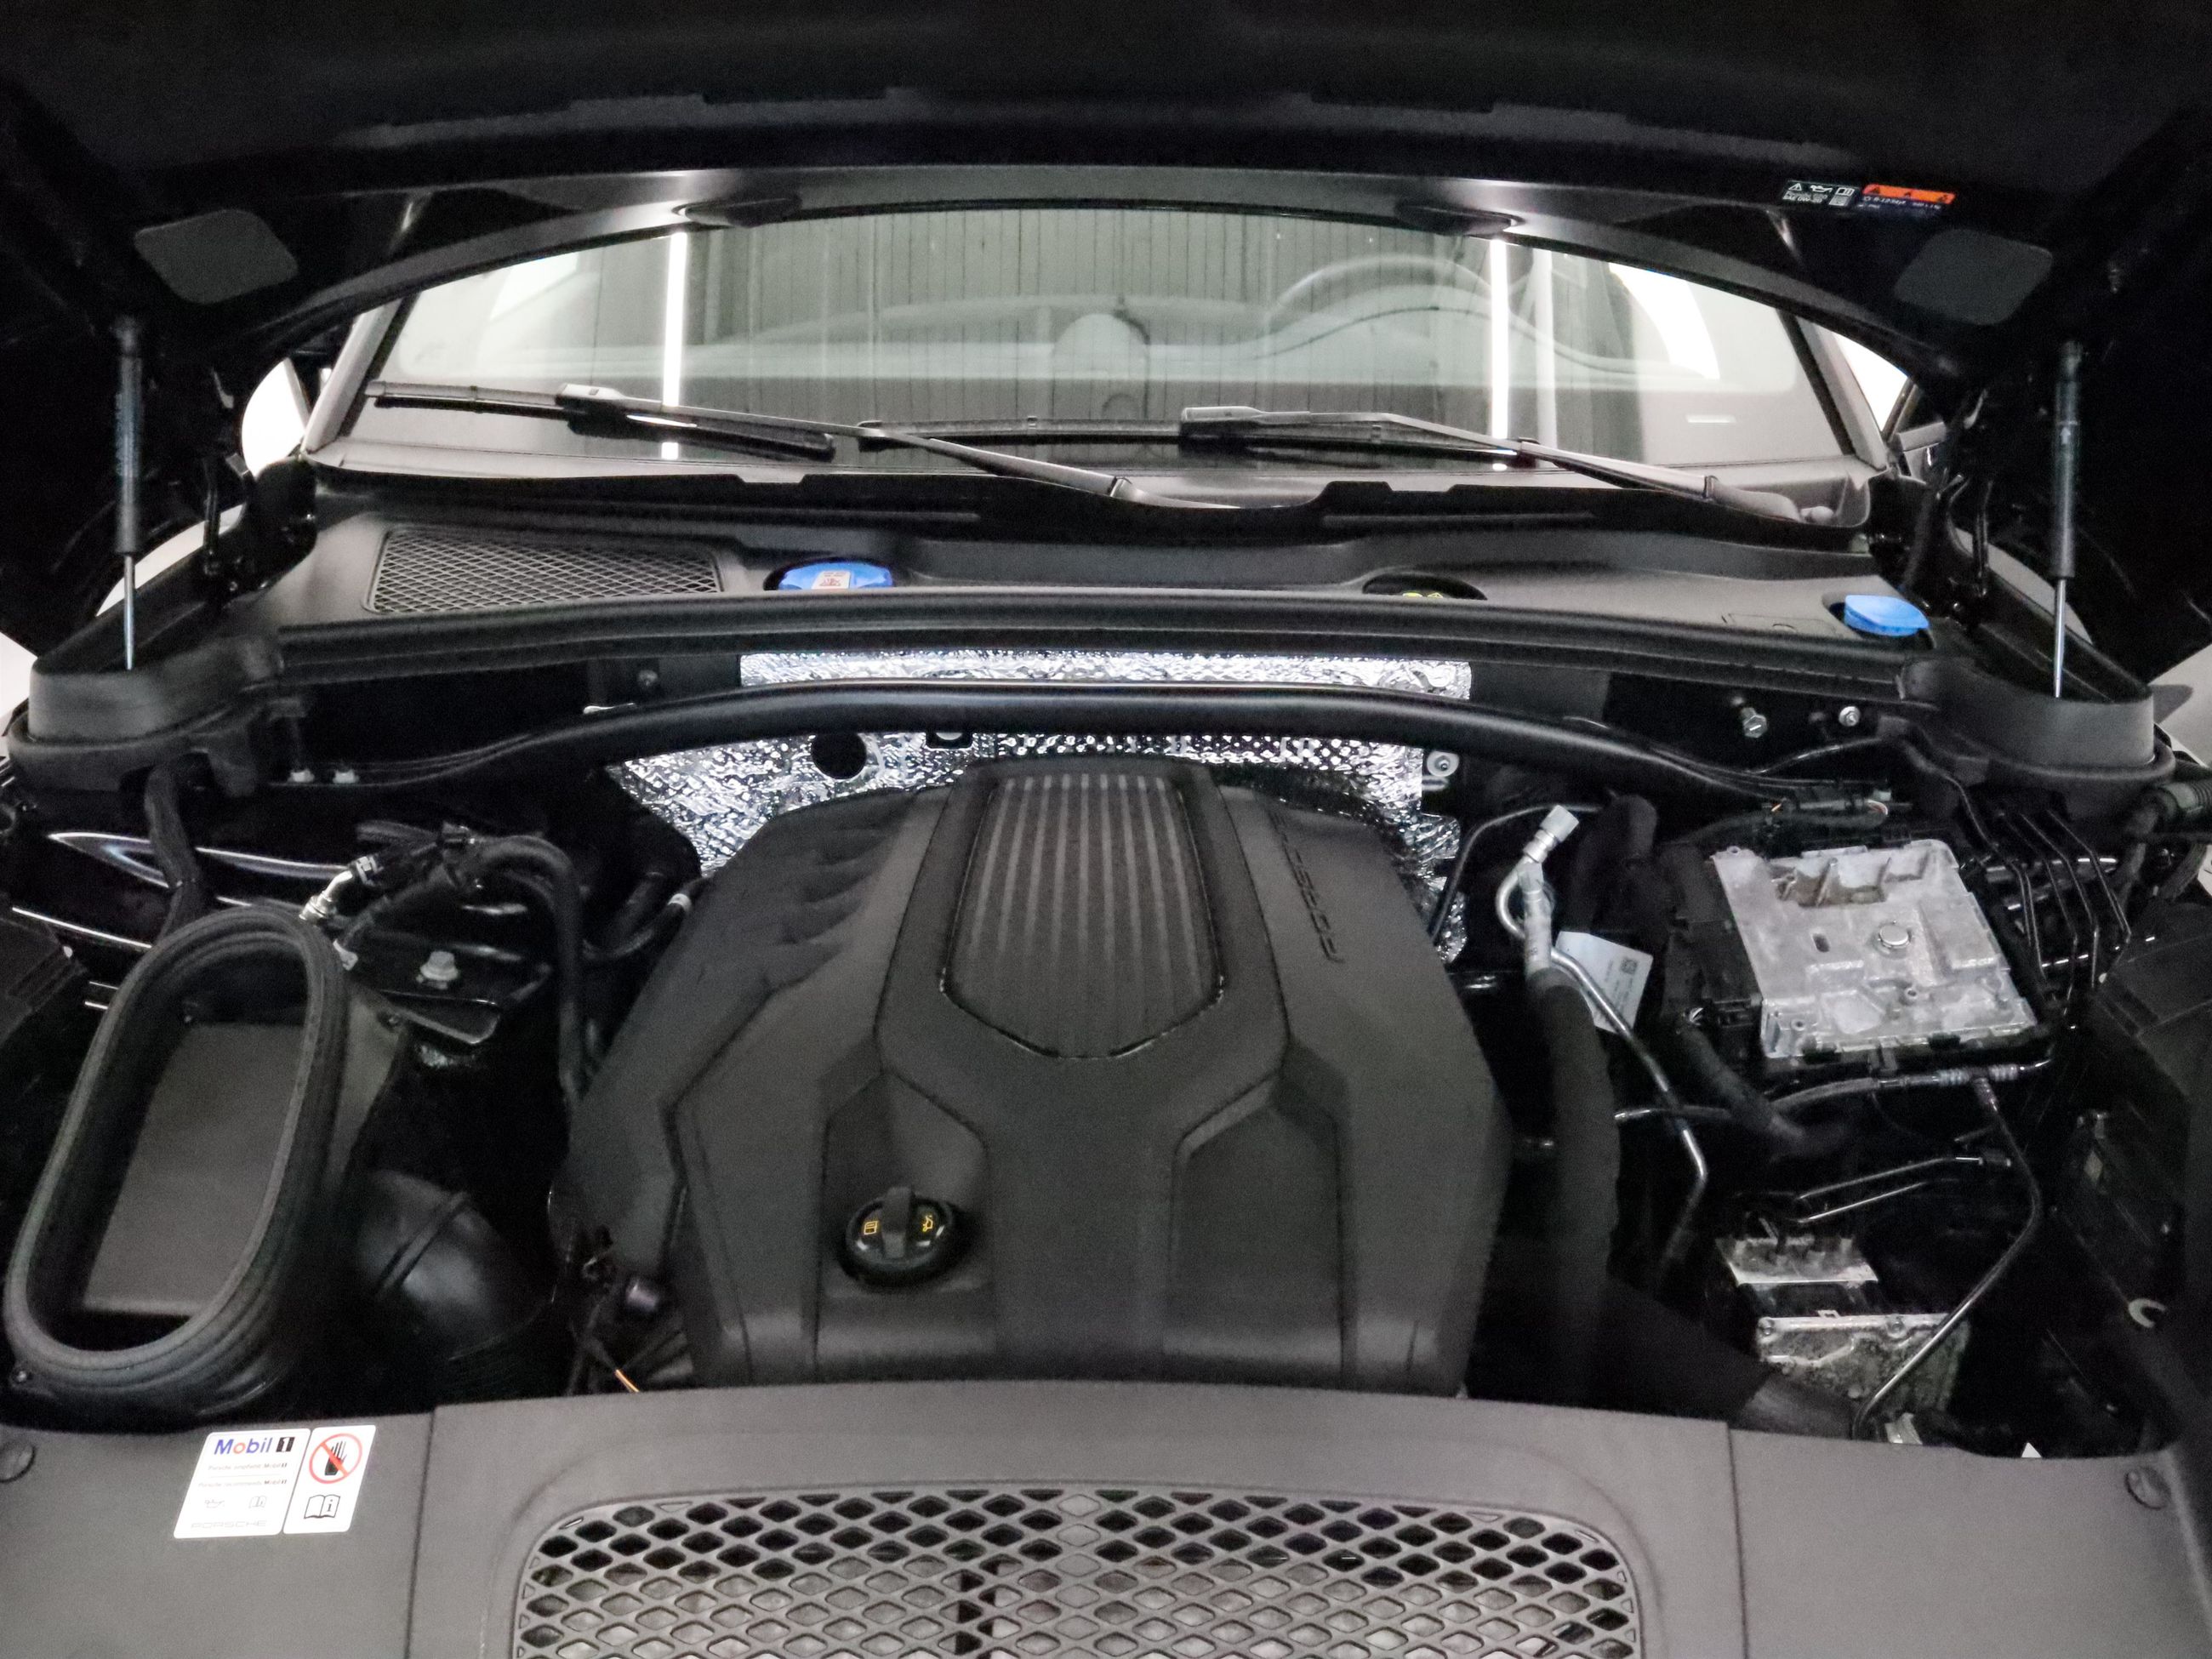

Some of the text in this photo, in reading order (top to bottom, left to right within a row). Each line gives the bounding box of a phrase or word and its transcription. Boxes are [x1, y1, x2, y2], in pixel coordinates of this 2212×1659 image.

[214, 1437, 295, 1455] Mobil 1
[191, 1519, 267, 1529] PORSCHE
